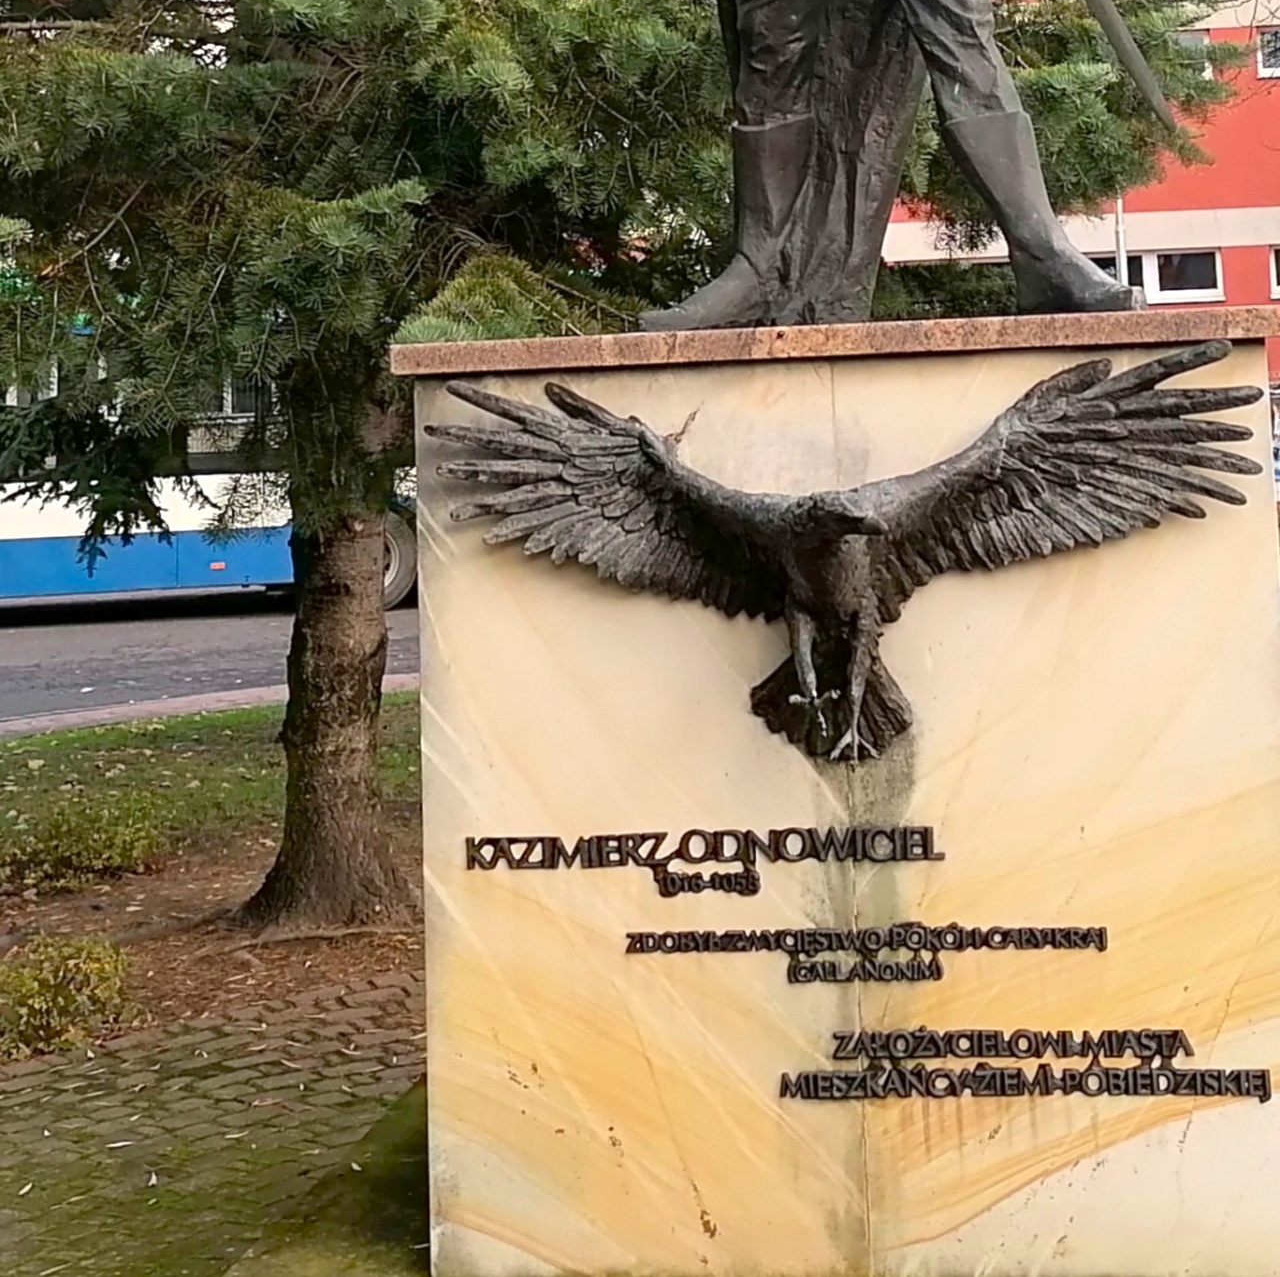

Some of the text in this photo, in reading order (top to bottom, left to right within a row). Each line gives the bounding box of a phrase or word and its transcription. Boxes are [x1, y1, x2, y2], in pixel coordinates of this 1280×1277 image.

[465, 826, 945, 870] KAZIMIERZ ODNOWICIEL
[1053, 926, 1108, 952] KRAJ
[1083, 1028, 1195, 1058] MIASTA
[779, 1063, 967, 1099] MIESZKAŃCY
[1062, 1067, 1272, 1104] POBIEDZISKIEJ
